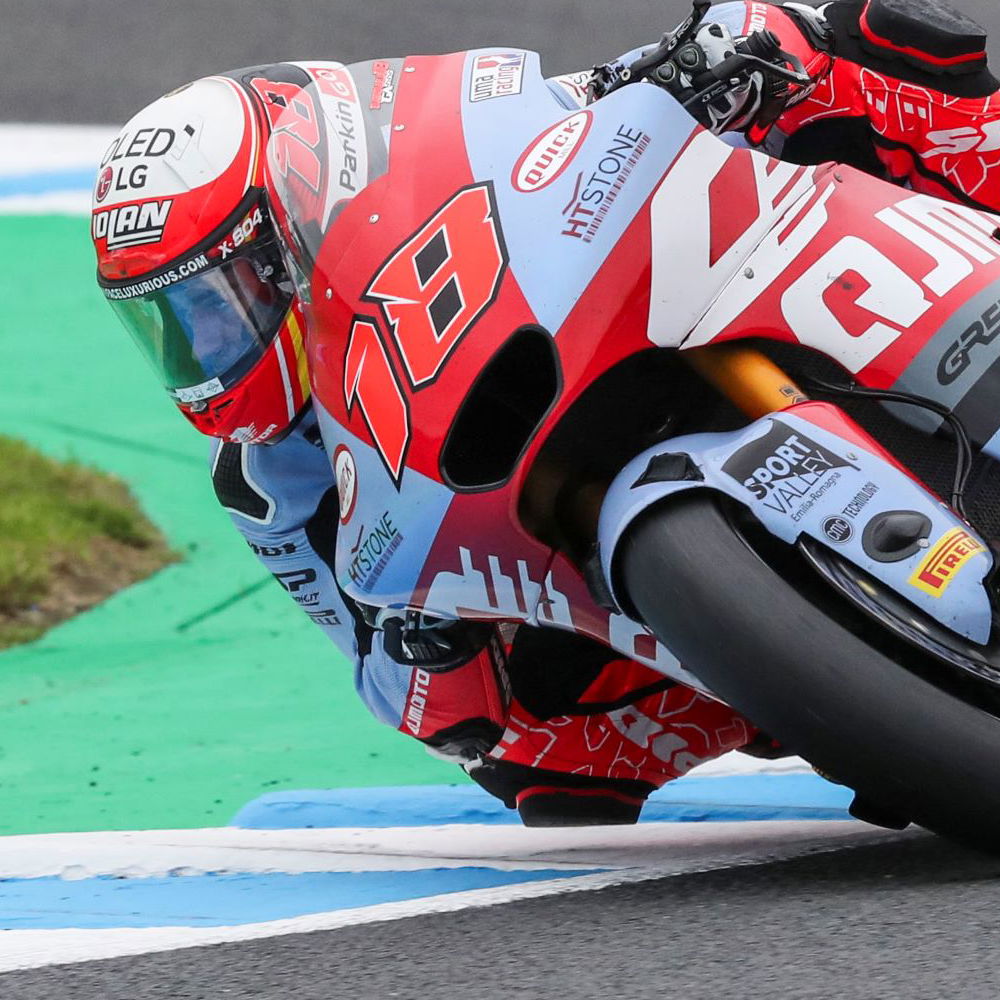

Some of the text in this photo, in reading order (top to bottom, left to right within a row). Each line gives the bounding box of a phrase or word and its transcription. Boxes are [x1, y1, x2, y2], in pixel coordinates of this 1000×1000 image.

[115, 164, 148, 191] LG
[524, 120, 580, 186] QUICK
[561, 124, 643, 239] HTSTONE
[92, 199, 173, 250] OLAN
[744, 434, 812, 500] SPORT
[763, 450, 834, 514] VALLEY
[790, 472, 841, 523] Emilia-Romagna
